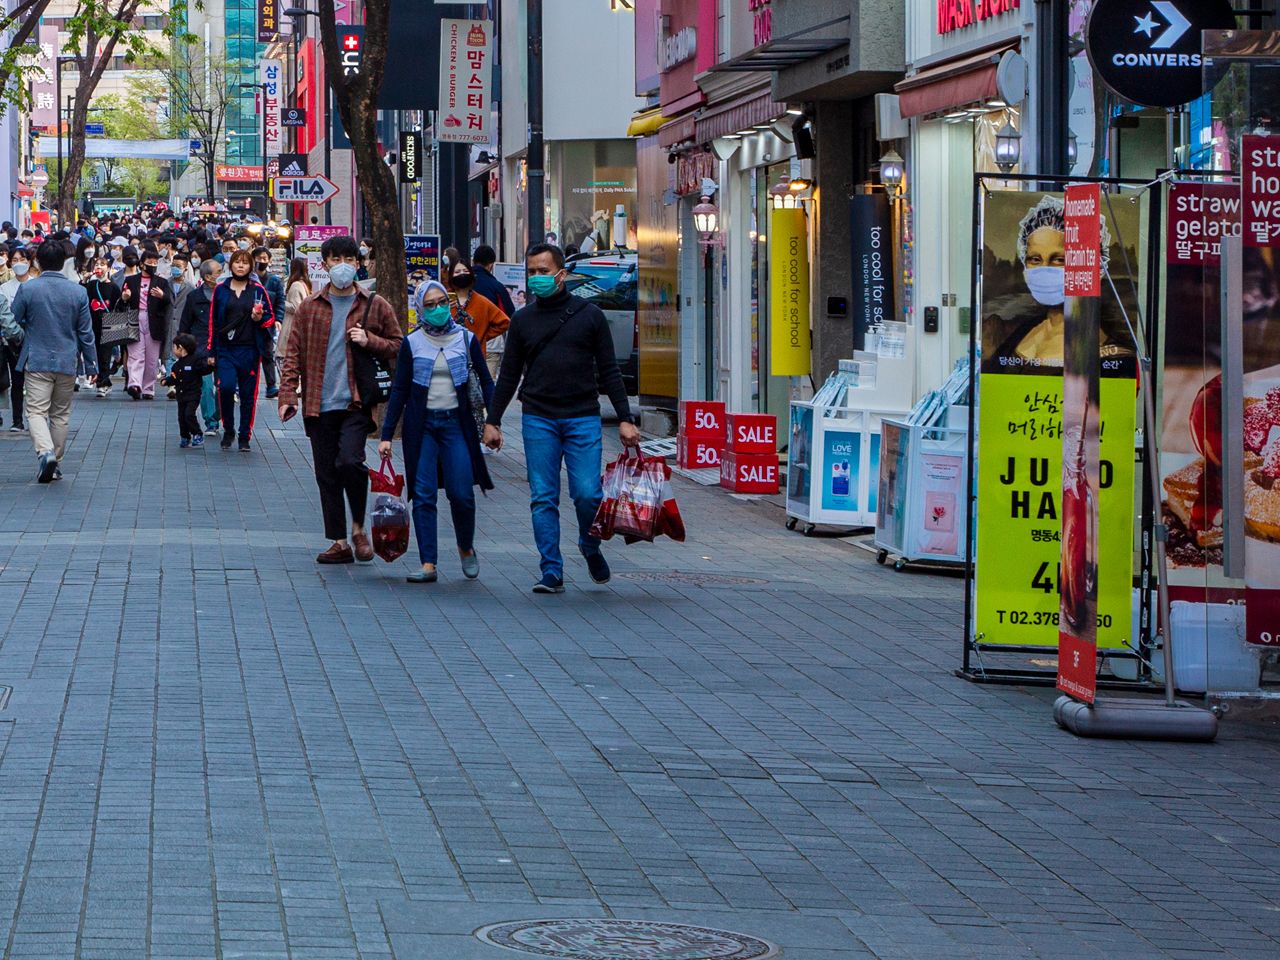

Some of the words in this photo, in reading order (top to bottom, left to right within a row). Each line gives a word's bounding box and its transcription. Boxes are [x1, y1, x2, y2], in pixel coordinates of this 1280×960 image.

[1112, 54, 1214, 67] CONVERSE
[449, 74, 457, 108] BURGER
[467, 51, 485, 130] 맘스터치
[279, 180, 325, 195] FILA
[1066, 196, 1095, 216] homemade
[871, 226, 882, 248] too
[1066, 221, 1079, 243] fruit
[790, 236, 798, 255] too
[872, 252, 884, 281] cool
[1087, 249, 1095, 267] tea
[790, 259, 799, 284] cool
[790, 288, 801, 305] for
[873, 285, 884, 304] for
[790, 308, 801, 348] school
[738, 426, 773, 443] SALE
[740, 466, 775, 483] SALE
[1000, 457, 1113, 488] JUO
[1011, 491, 1057, 519] HA
[997, 611, 1006, 623] T
